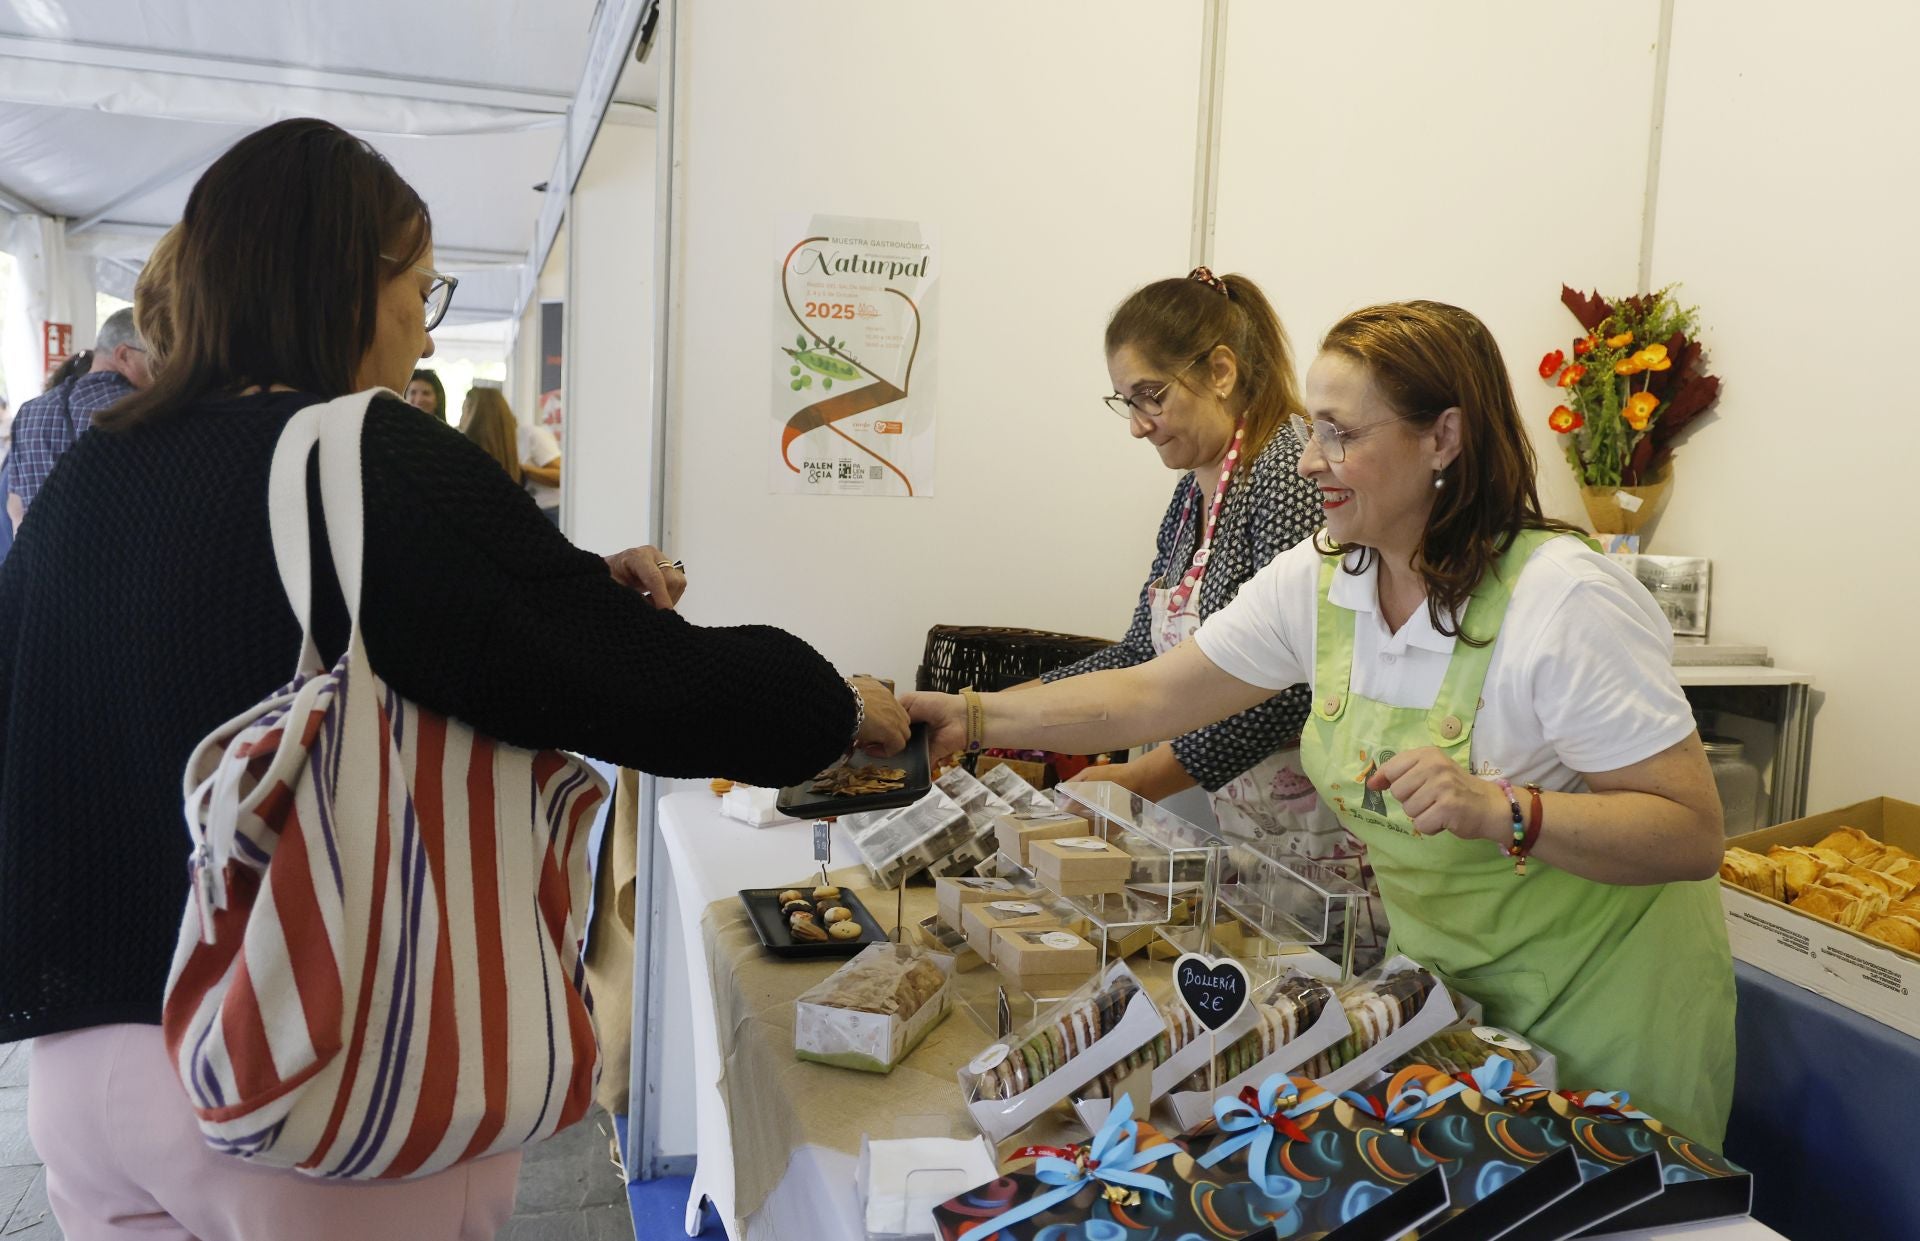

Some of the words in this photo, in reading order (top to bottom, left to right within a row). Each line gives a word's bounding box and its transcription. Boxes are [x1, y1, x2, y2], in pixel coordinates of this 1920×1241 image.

[832, 237, 868, 247] MUESTRA
[870, 239, 931, 250] GASTRONÓMICA
[793, 248, 930, 280] Naturpal
[805, 302, 855, 320] 2025
[803, 462, 833, 470] PALEN
[1183, 967, 1236, 994] BOLLERÍA
[1199, 992, 1224, 1011] 2€
